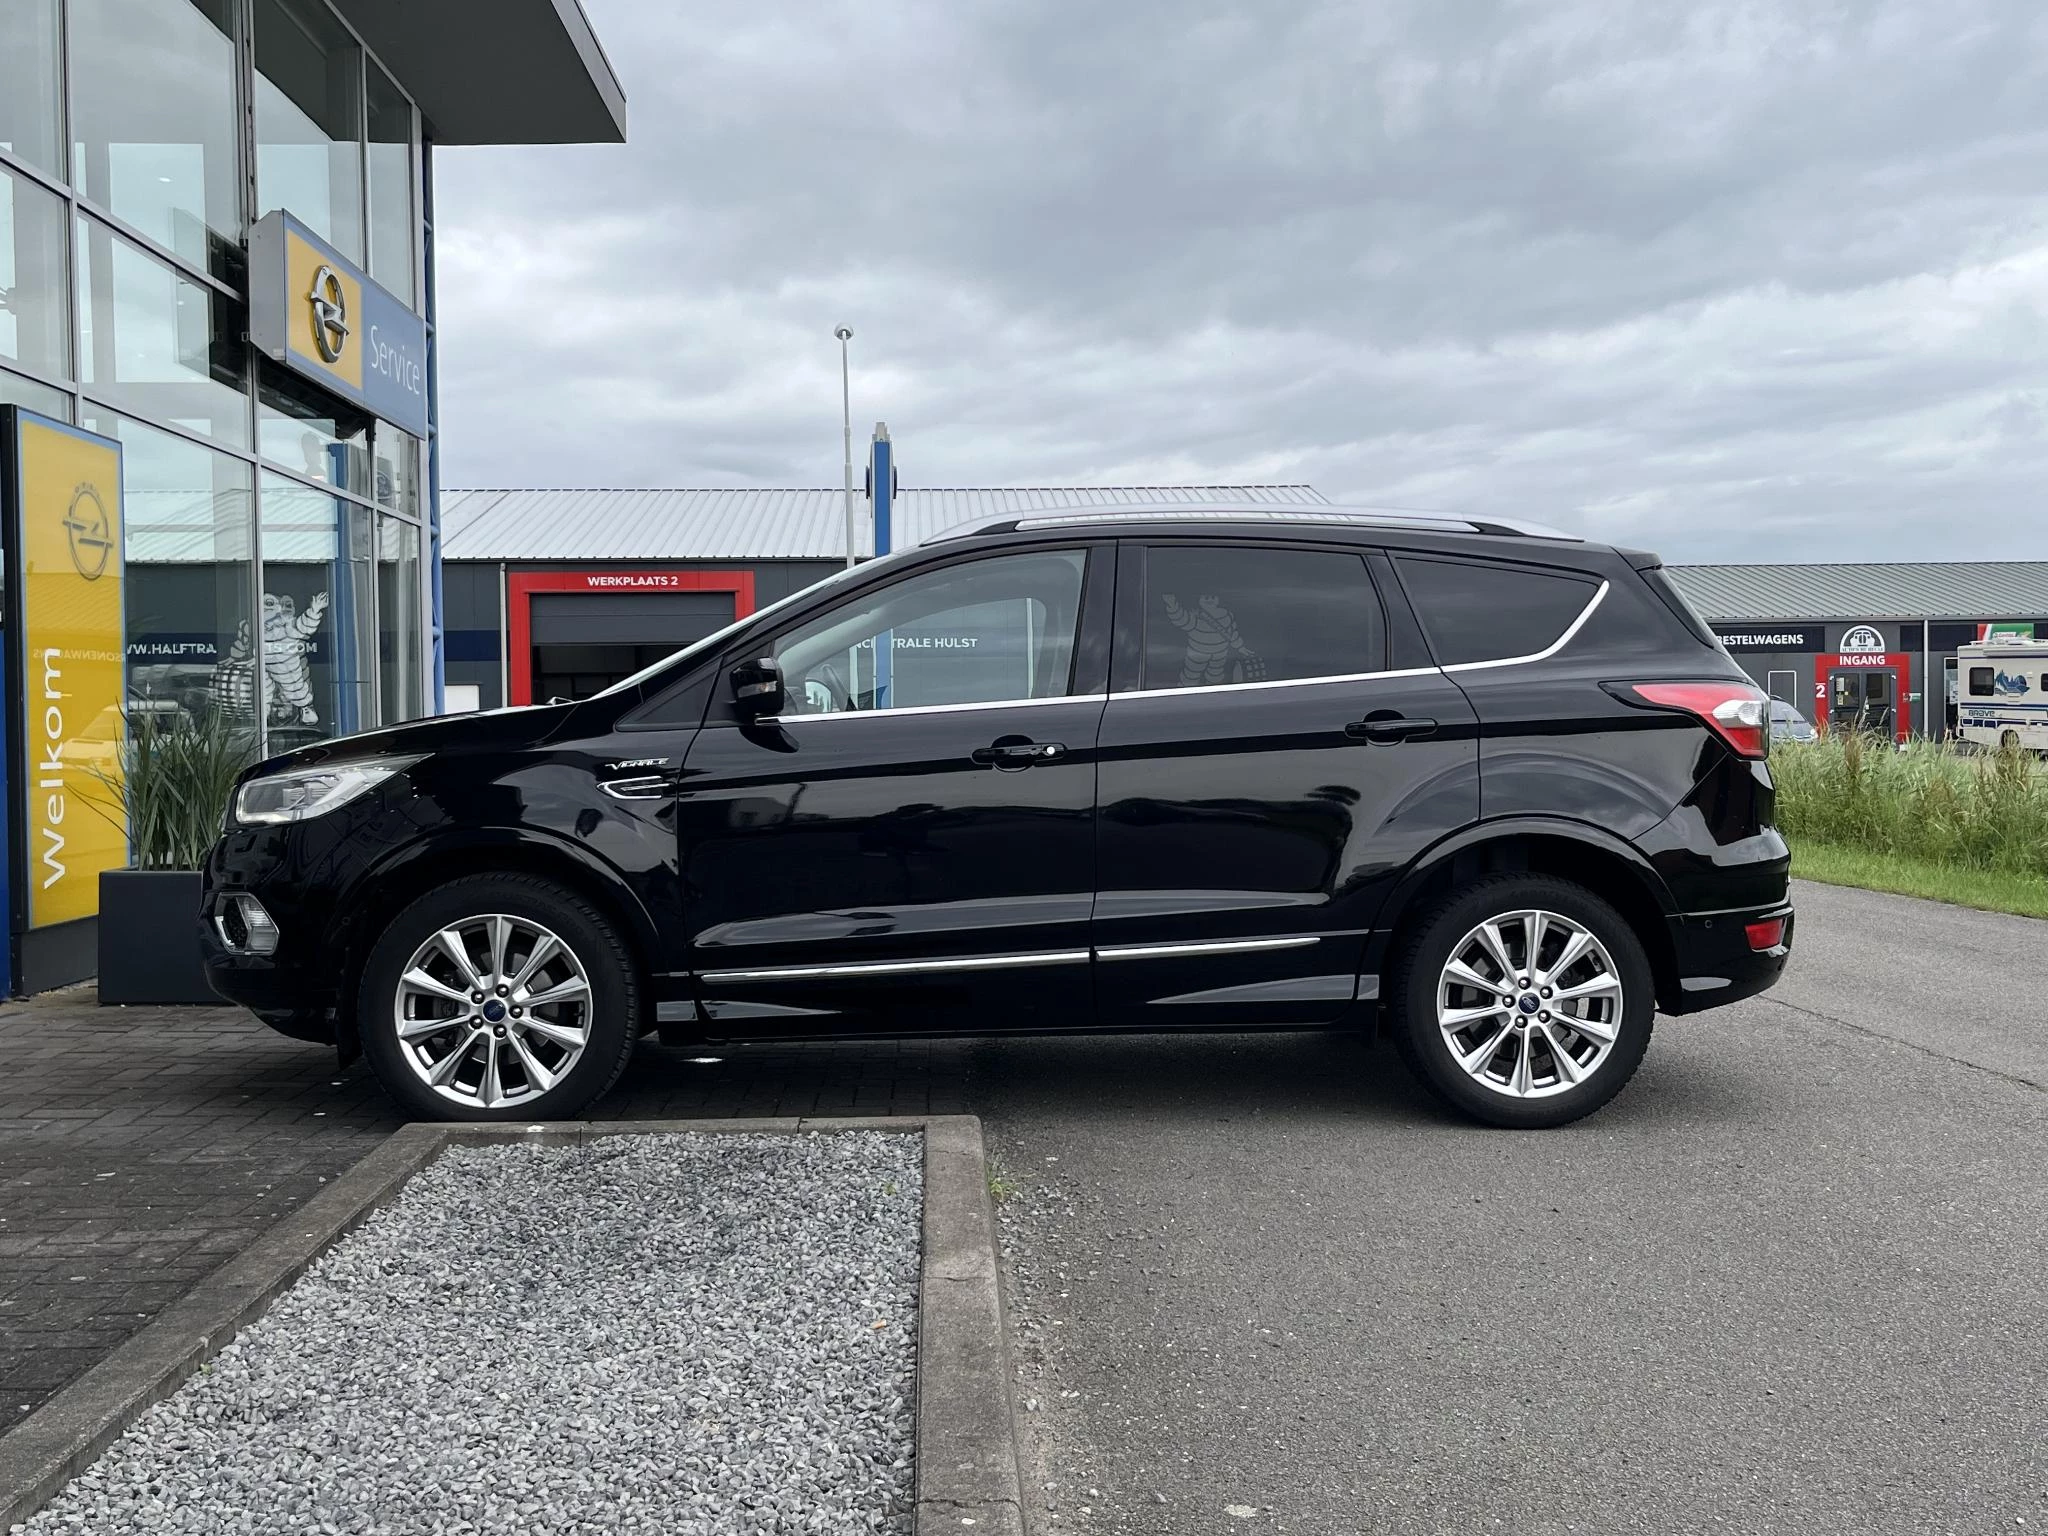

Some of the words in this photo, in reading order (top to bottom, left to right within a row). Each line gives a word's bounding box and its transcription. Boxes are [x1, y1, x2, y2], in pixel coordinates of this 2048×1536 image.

[370, 325, 420, 395] Service
[587, 576, 669, 586] WERKPLAATS
[670, 576, 679, 586] 2
[934, 638, 978, 648] HULST
[1839, 655, 1886, 666] INGANG
[1815, 684, 1826, 698] 2
[40, 648, 66, 889] Welkom
